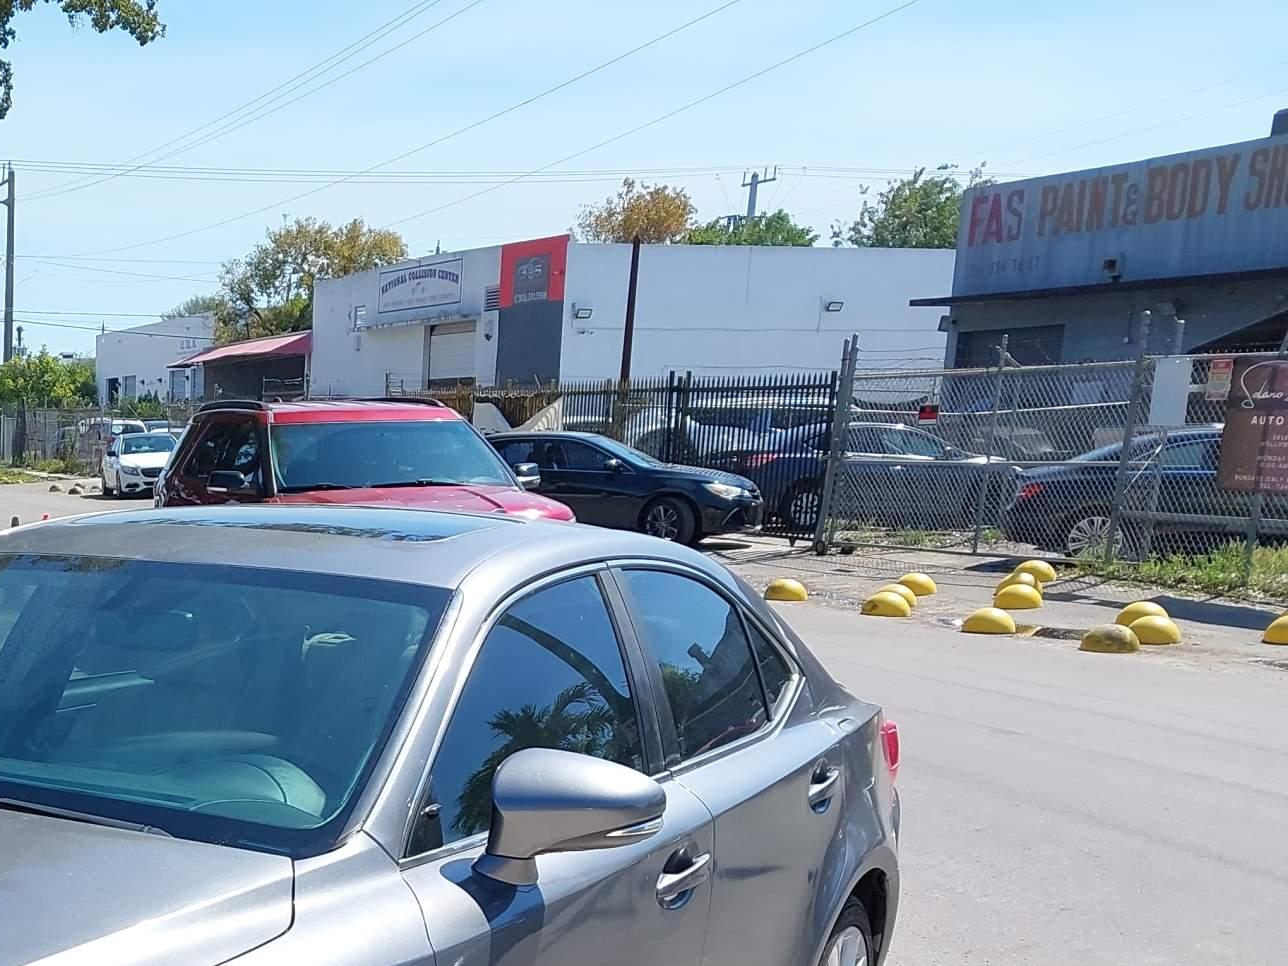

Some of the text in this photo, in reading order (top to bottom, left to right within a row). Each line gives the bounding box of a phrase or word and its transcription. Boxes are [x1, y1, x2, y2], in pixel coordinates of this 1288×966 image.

[969, 189, 1025, 246] FAS
[1038, 173, 1128, 237] PAINT
[1144, 154, 1242, 224] BODY
[1244, 144, 1288, 211] SH
[381, 273, 407, 296] NATIONAL
[408, 268, 437, 282] COLLISION
[438, 269, 459, 285] CENTER
[1251, 415, 1285, 425] AUTO
